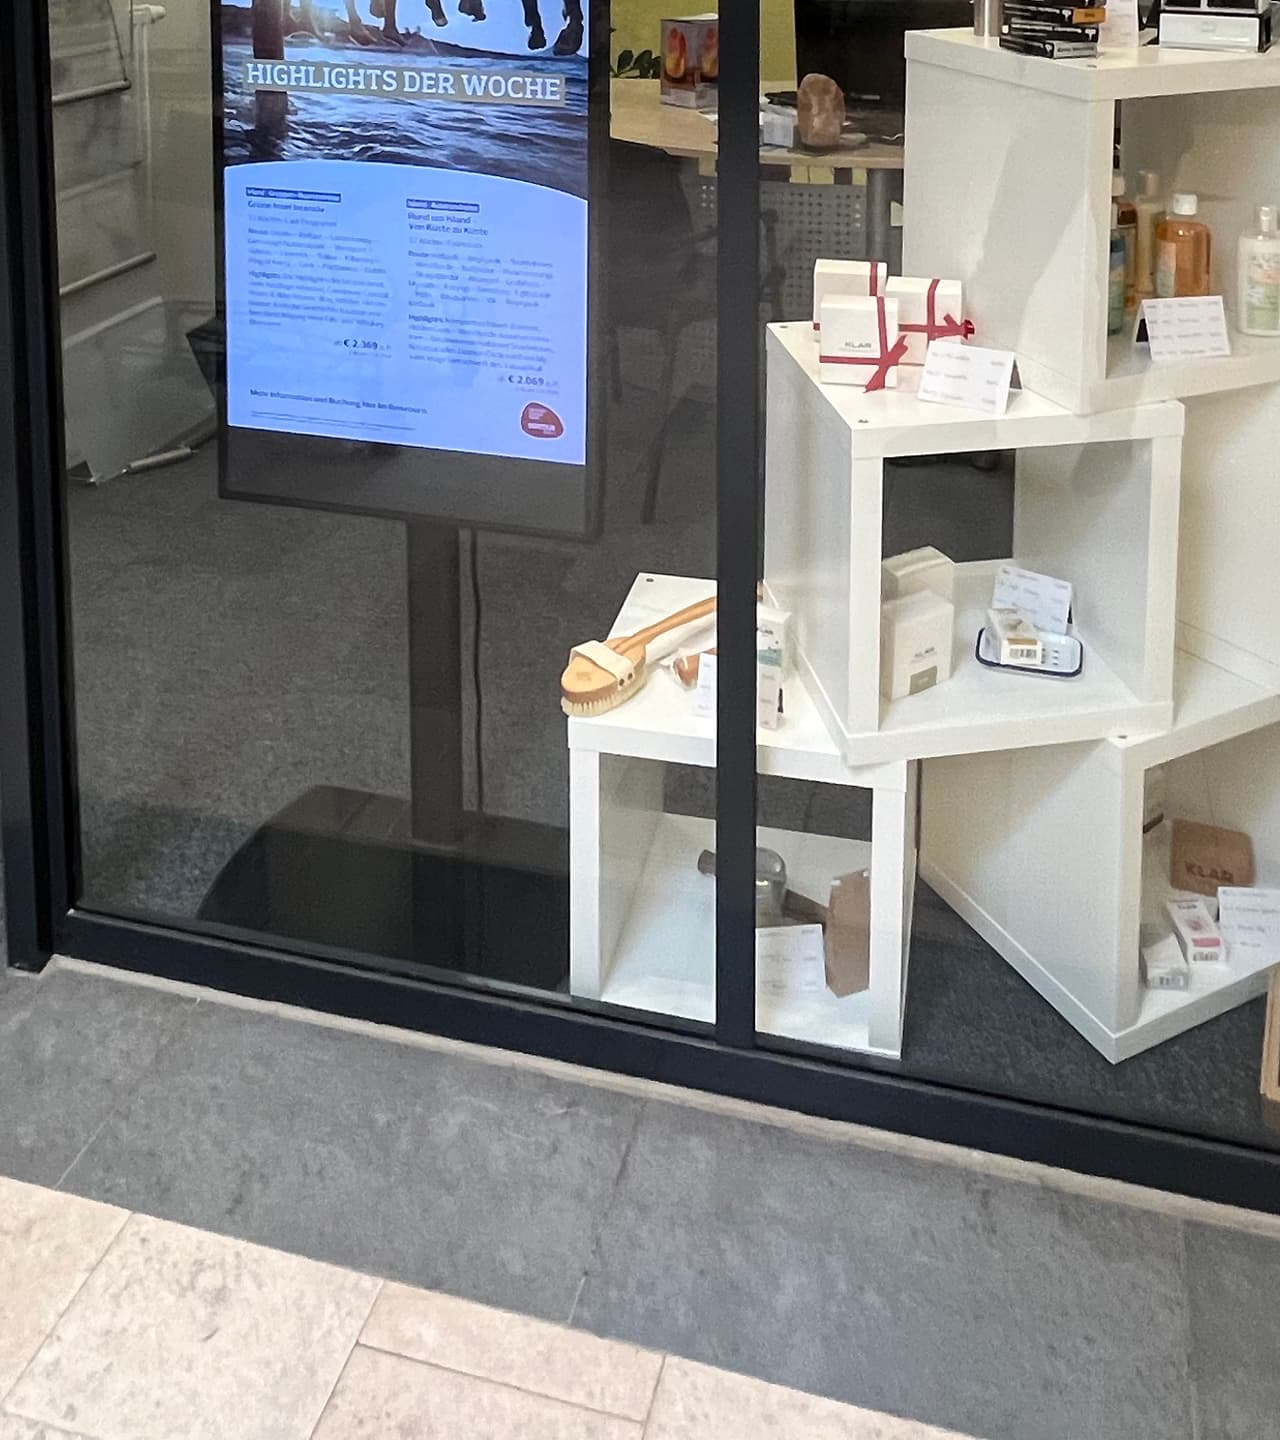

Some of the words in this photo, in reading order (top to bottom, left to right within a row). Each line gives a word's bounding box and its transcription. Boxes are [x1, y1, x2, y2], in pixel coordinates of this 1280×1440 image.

[246, 63, 398, 92] HIGHLIGHTS
[403, 71, 456, 95] DER
[462, 73, 561, 101] WOCHE
